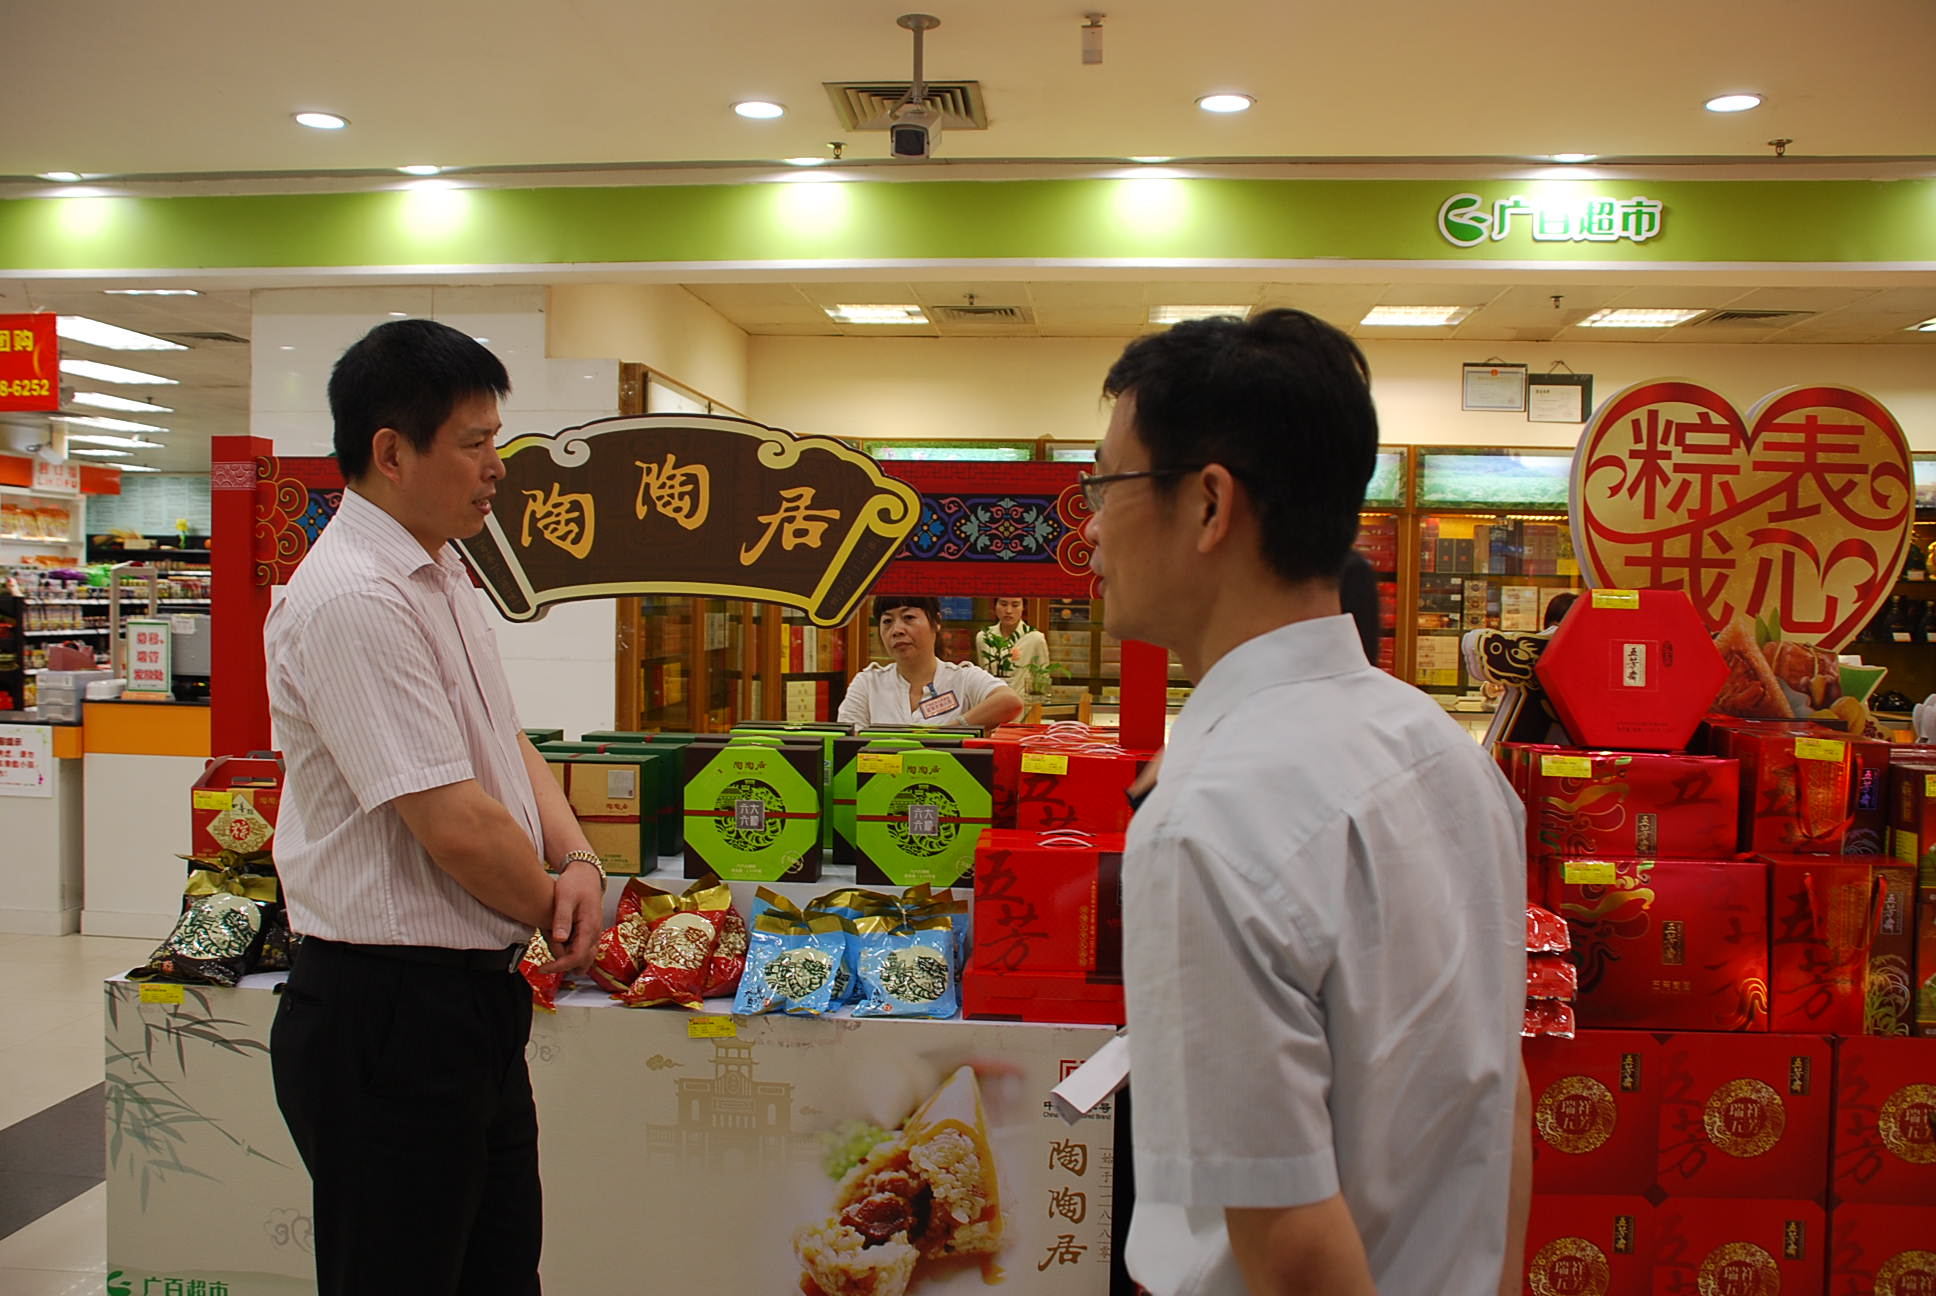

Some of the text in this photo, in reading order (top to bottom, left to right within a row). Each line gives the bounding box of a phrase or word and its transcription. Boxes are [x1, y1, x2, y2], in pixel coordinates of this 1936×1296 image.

[1495, 198, 1661, 238] 广百超市
[520, 453, 841, 566] 陶陶居
[1627, 410, 1869, 523] 粽表
[1624, 528, 1839, 634] 我心
[1038, 1138, 1088, 1272] 陶陶居
